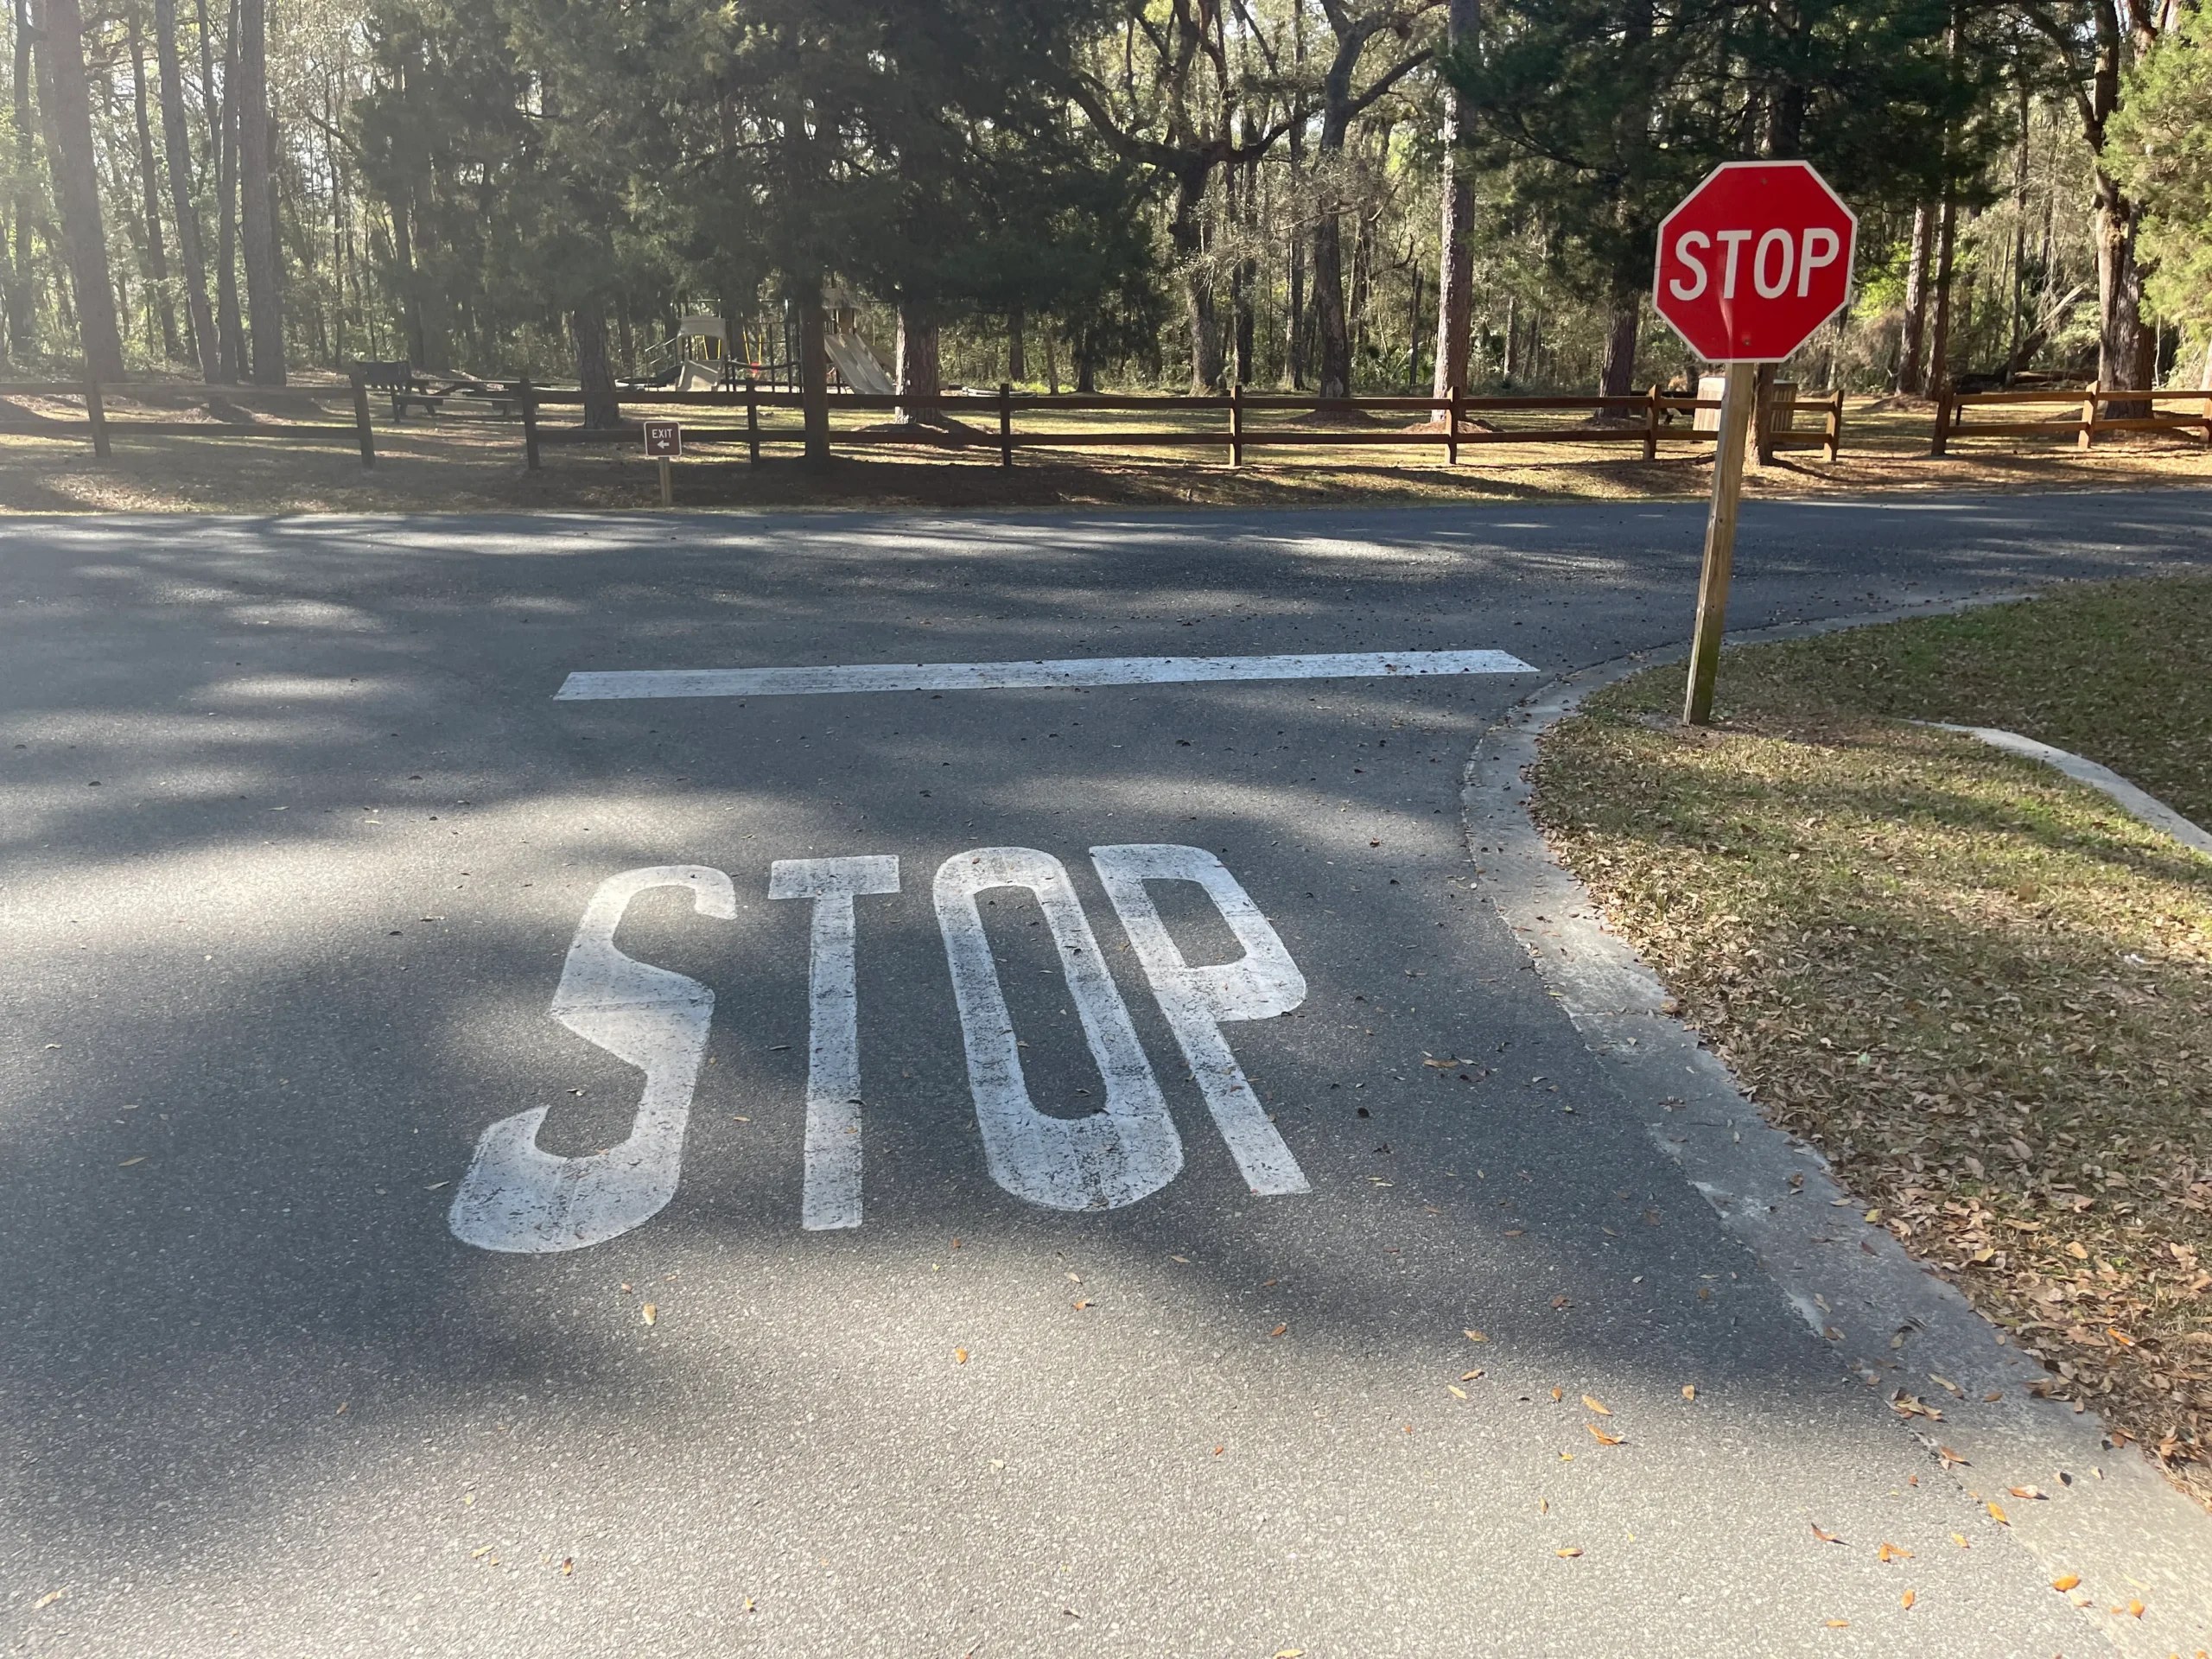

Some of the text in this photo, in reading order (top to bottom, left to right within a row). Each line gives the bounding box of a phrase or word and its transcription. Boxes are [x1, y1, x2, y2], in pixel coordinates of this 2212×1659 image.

[1669, 228, 1840, 301] STOP
[652, 429, 672, 439] EXIT
[448, 843, 1311, 1253] STOP
